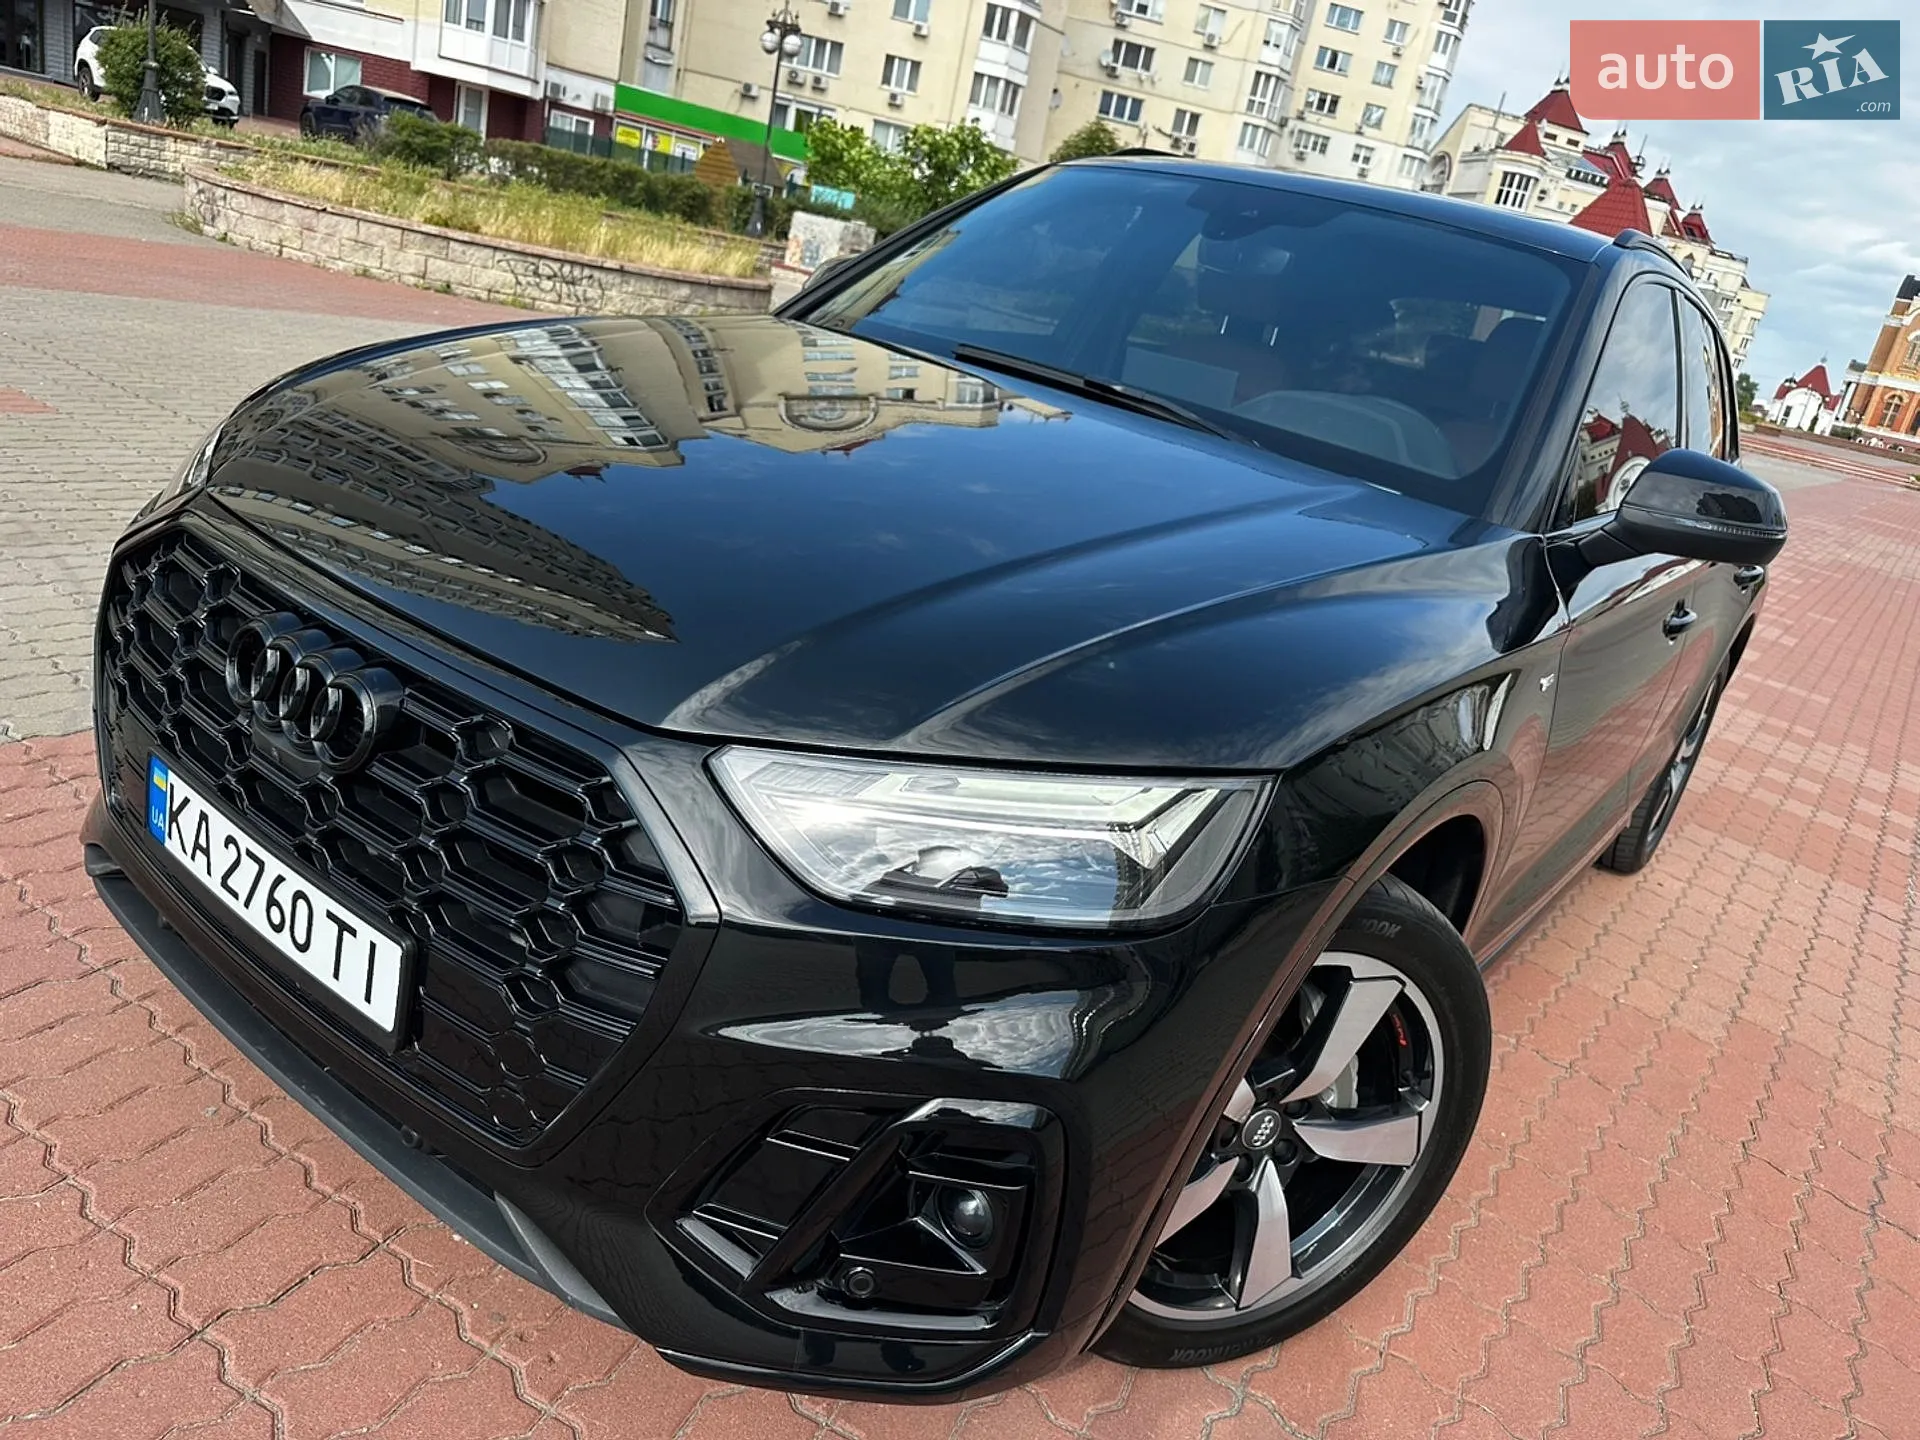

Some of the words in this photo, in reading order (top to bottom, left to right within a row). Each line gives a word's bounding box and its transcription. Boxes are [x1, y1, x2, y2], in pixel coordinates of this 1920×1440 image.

[151, 804, 165, 832] UA
[219, 834, 314, 954] 2760
[325, 908, 377, 1005] TI
